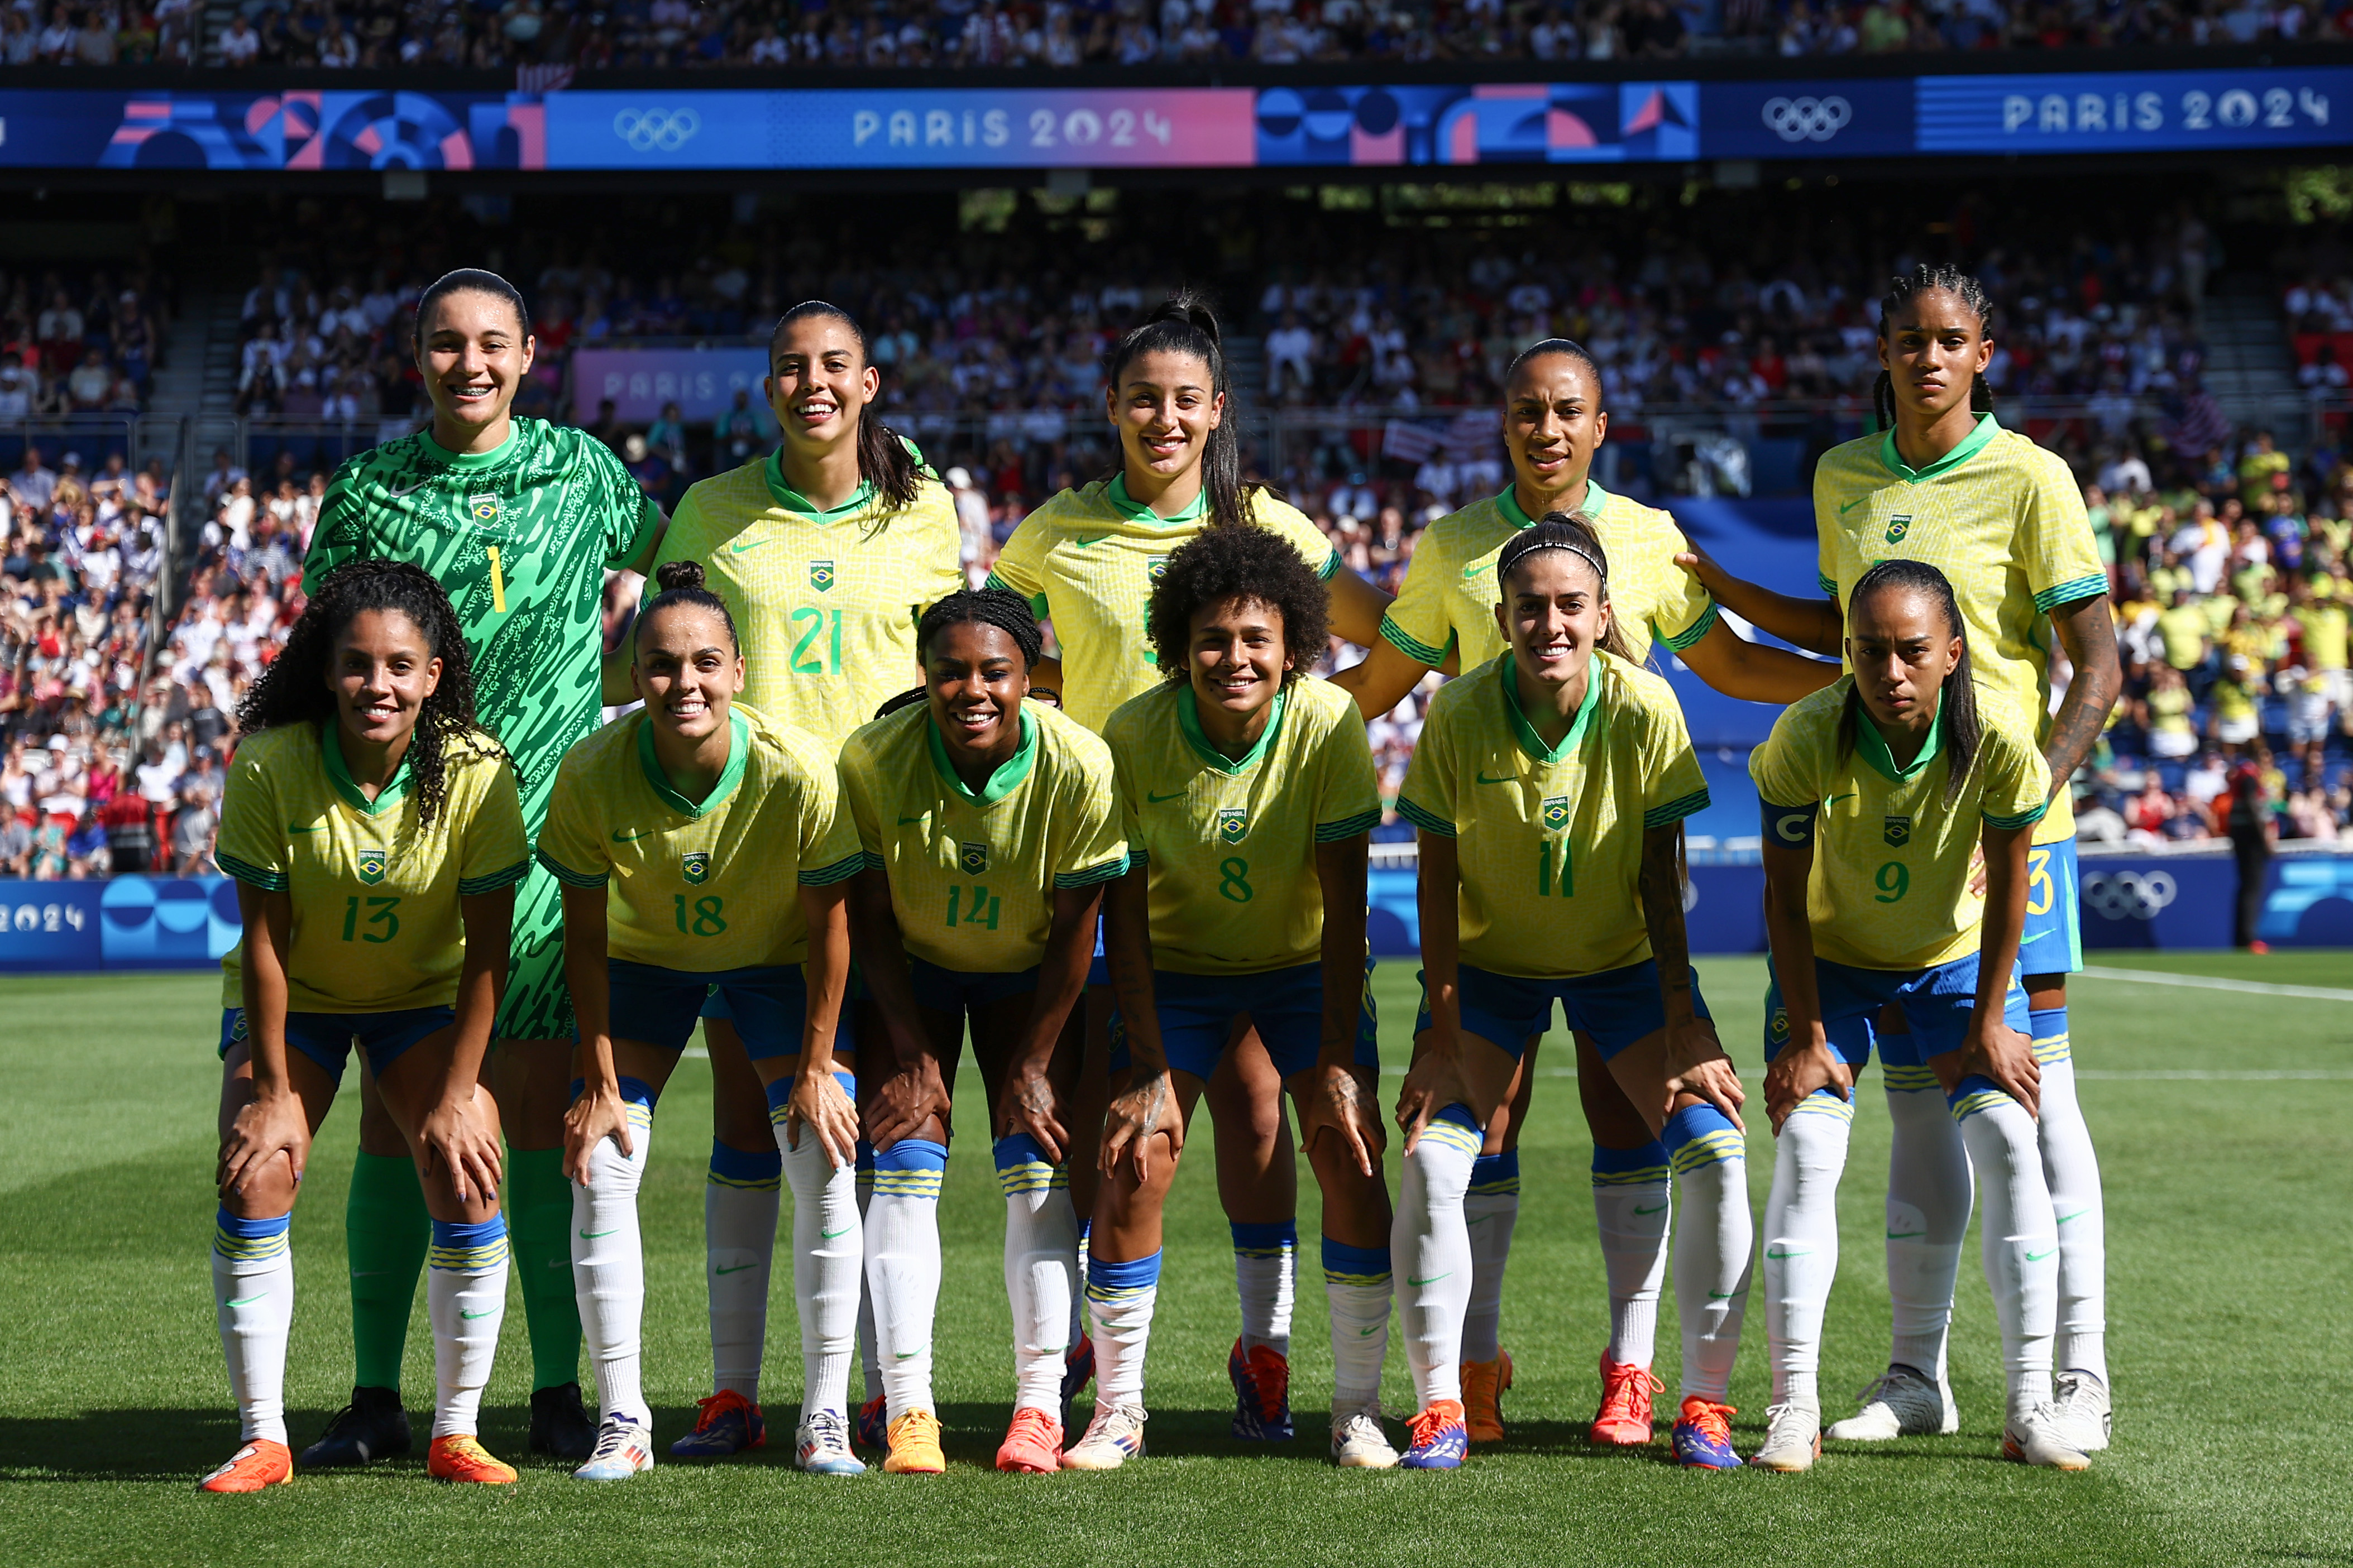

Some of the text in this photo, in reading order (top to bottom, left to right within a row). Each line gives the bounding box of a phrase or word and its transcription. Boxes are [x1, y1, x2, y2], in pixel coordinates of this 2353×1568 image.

[1029, 108, 1170, 147] 2024
[2181, 86, 2329, 131] 2024
[487, 546, 506, 613] 1
[790, 607, 841, 675] 21
[1776, 814, 1809, 842] C
[1219, 857, 1253, 903] 8
[1539, 838, 1573, 897] 11
[1875, 861, 1909, 903] 9
[2025, 850, 2053, 915] 3
[342, 896, 401, 943] 13
[675, 894, 727, 937] 18
[946, 885, 1000, 930] 14
